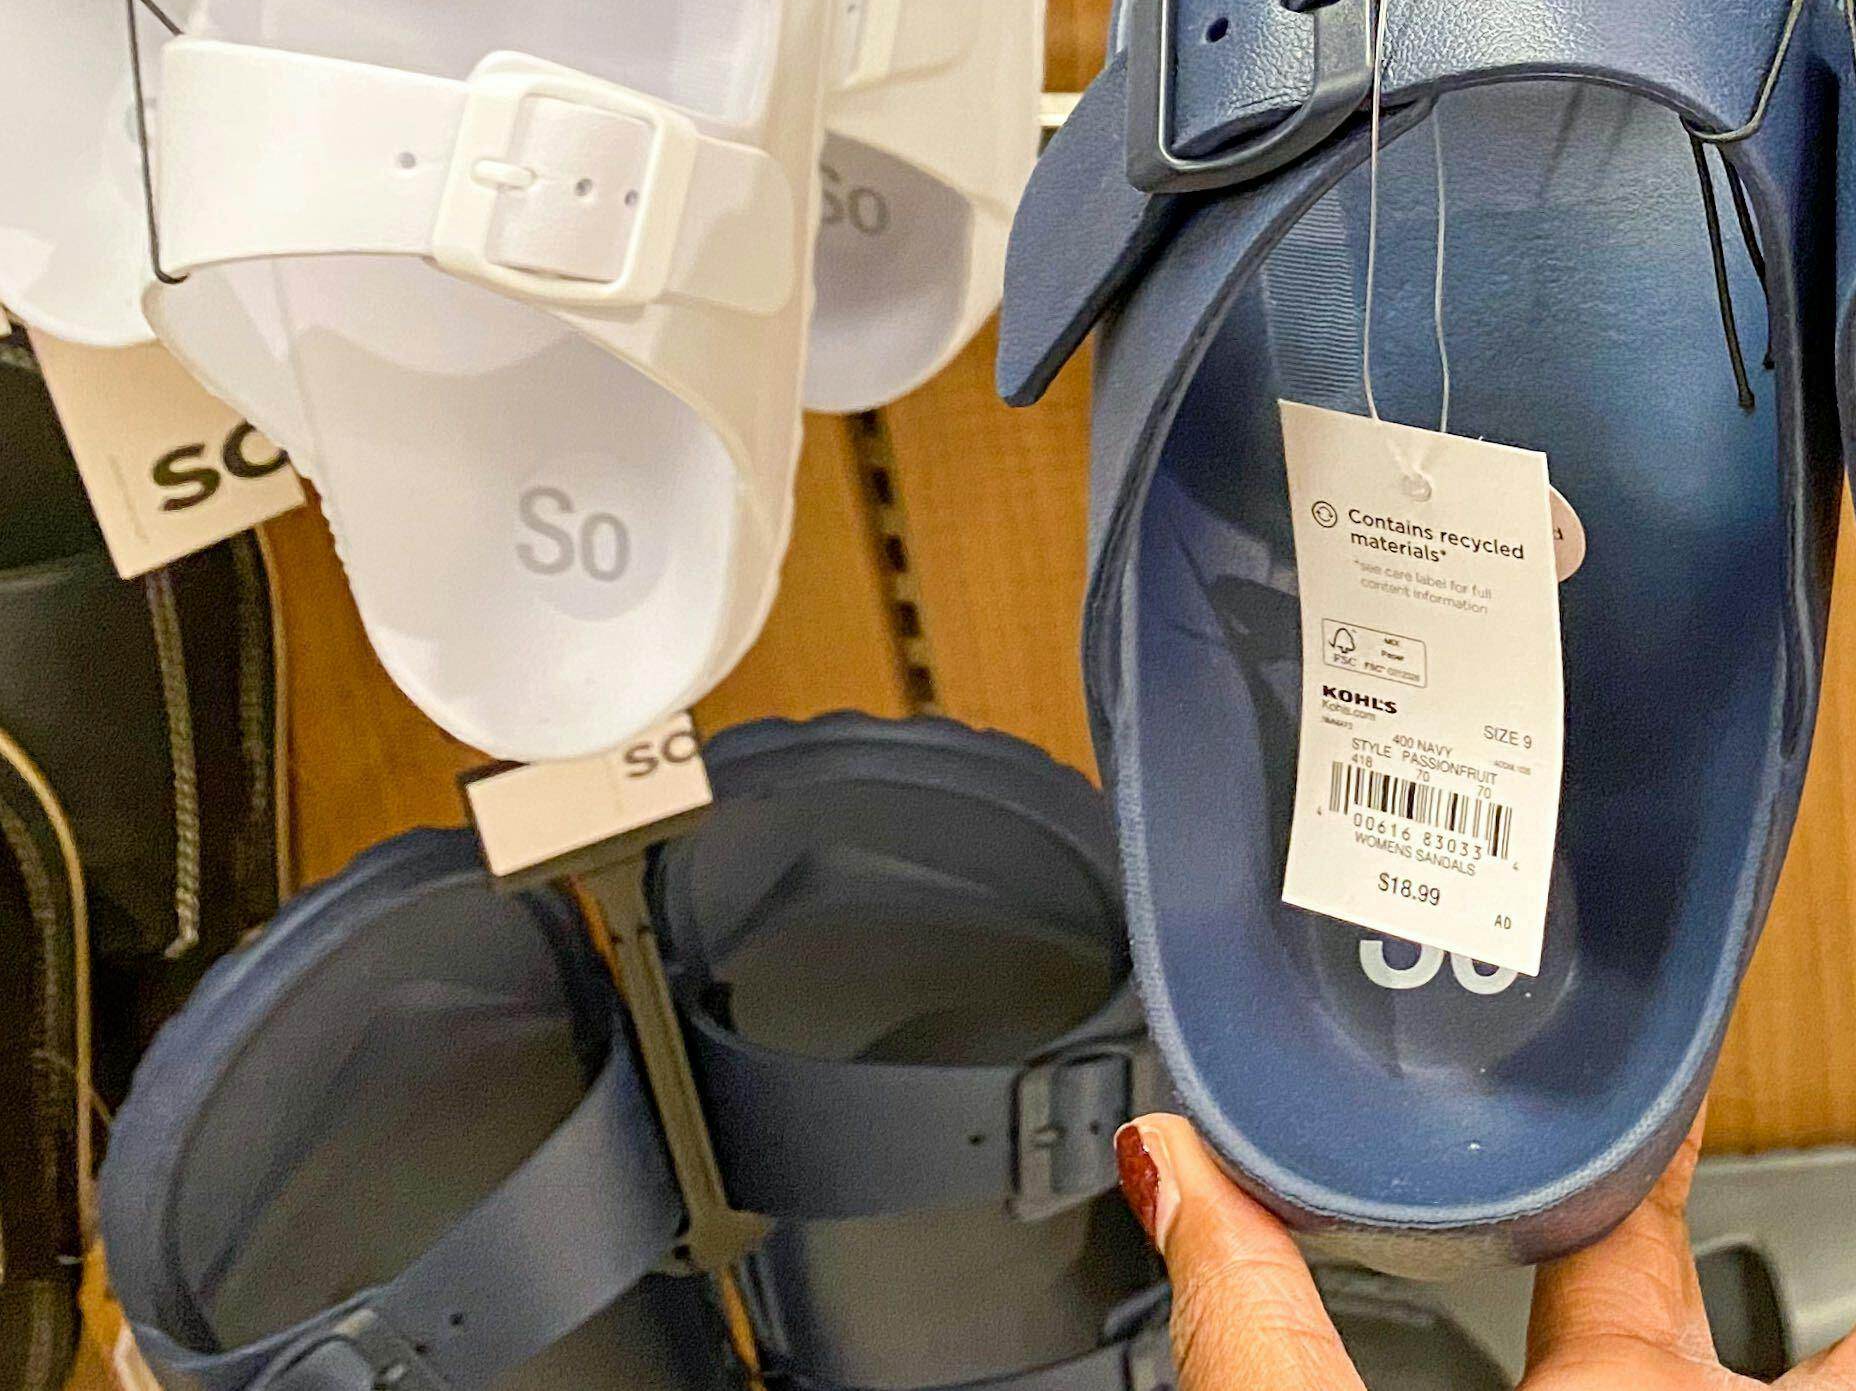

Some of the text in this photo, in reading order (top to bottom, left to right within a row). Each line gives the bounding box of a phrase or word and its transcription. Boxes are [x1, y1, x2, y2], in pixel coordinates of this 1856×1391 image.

[516, 485, 631, 582] So
[1348, 508, 1434, 540] Contains
[1440, 530, 1525, 560] recycled
[1322, 684, 1398, 714] KOHL'S
[1392, 734, 1453, 758] 400 NAVY
[1483, 724, 1533, 750] SIZE 9
[1351, 737, 1393, 759] STYLE
[1402, 750, 1499, 785] PASSIONFRUIT
[1416, 768, 1431, 783] 70
[1478, 785, 1493, 800] 70
[1353, 812, 1412, 842] 00616
[1423, 830, 1484, 862] 83033
[1354, 830, 1477, 877] WOMENS SANDALS
[1377, 871, 1441, 907] $18.99
